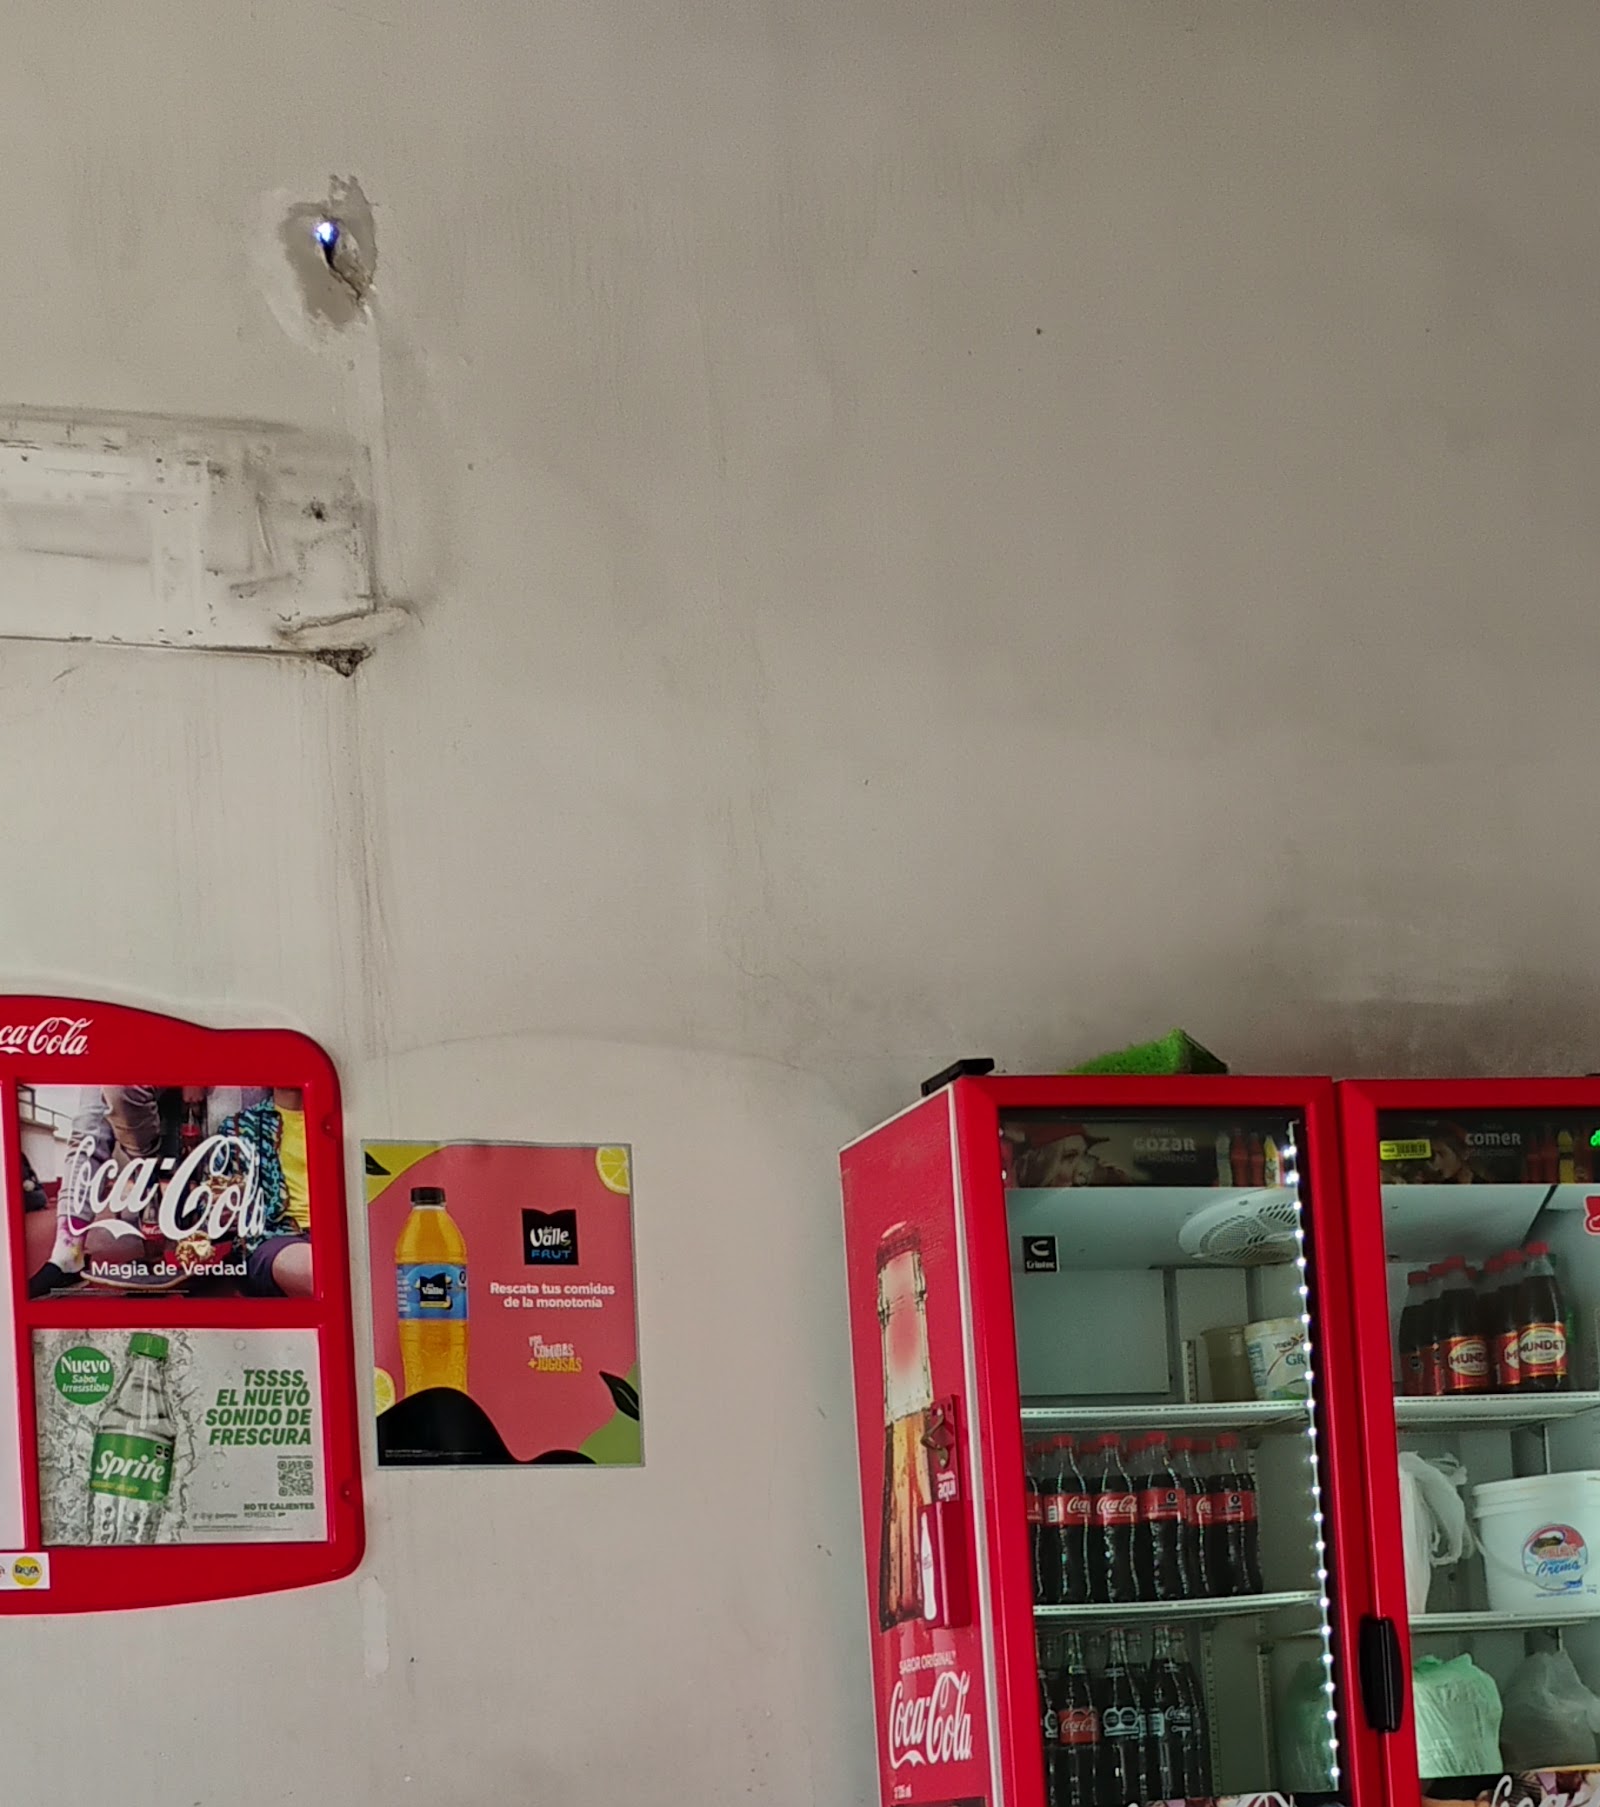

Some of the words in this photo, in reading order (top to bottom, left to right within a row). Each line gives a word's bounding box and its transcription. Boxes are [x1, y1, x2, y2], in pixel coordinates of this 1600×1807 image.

[67, 1134, 267, 1240] Coca-Cola
[530, 1227, 571, 1247] Valle
[531, 1250, 571, 1259] FRUT
[91, 1261, 149, 1279] Magia
[153, 1261, 177, 1276] de
[181, 1261, 247, 1276] Verdad
[490, 1282, 539, 1295] Rescata
[542, 1284, 561, 1295] tus
[564, 1283, 615, 1295] comidas
[503, 1296, 520, 1308] de
[522, 1296, 533, 1308] la
[536, 1296, 603, 1309] monotonía
[1518, 1340, 1565, 1353] MUNDET
[60, 1356, 110, 1374] Nuevo
[1450, 1352, 1485, 1366] MUND
[62, 1382, 110, 1393] Irresistible
[71, 1374, 98, 1384] Sabor
[243, 1369, 308, 1391] TSSSS,
[216, 1389, 239, 1406] EL
[243, 1389, 311, 1406] NUEVO
[205, 1409, 283, 1426] SONIDO
[285, 1408, 312, 1425] DE
[208, 1428, 312, 1446] FRESCURA
[95, 1450, 165, 1483] Sprite
[269, 1502, 315, 1510] CALIENTES
[889, 1671, 973, 1770] Coca-Cola
